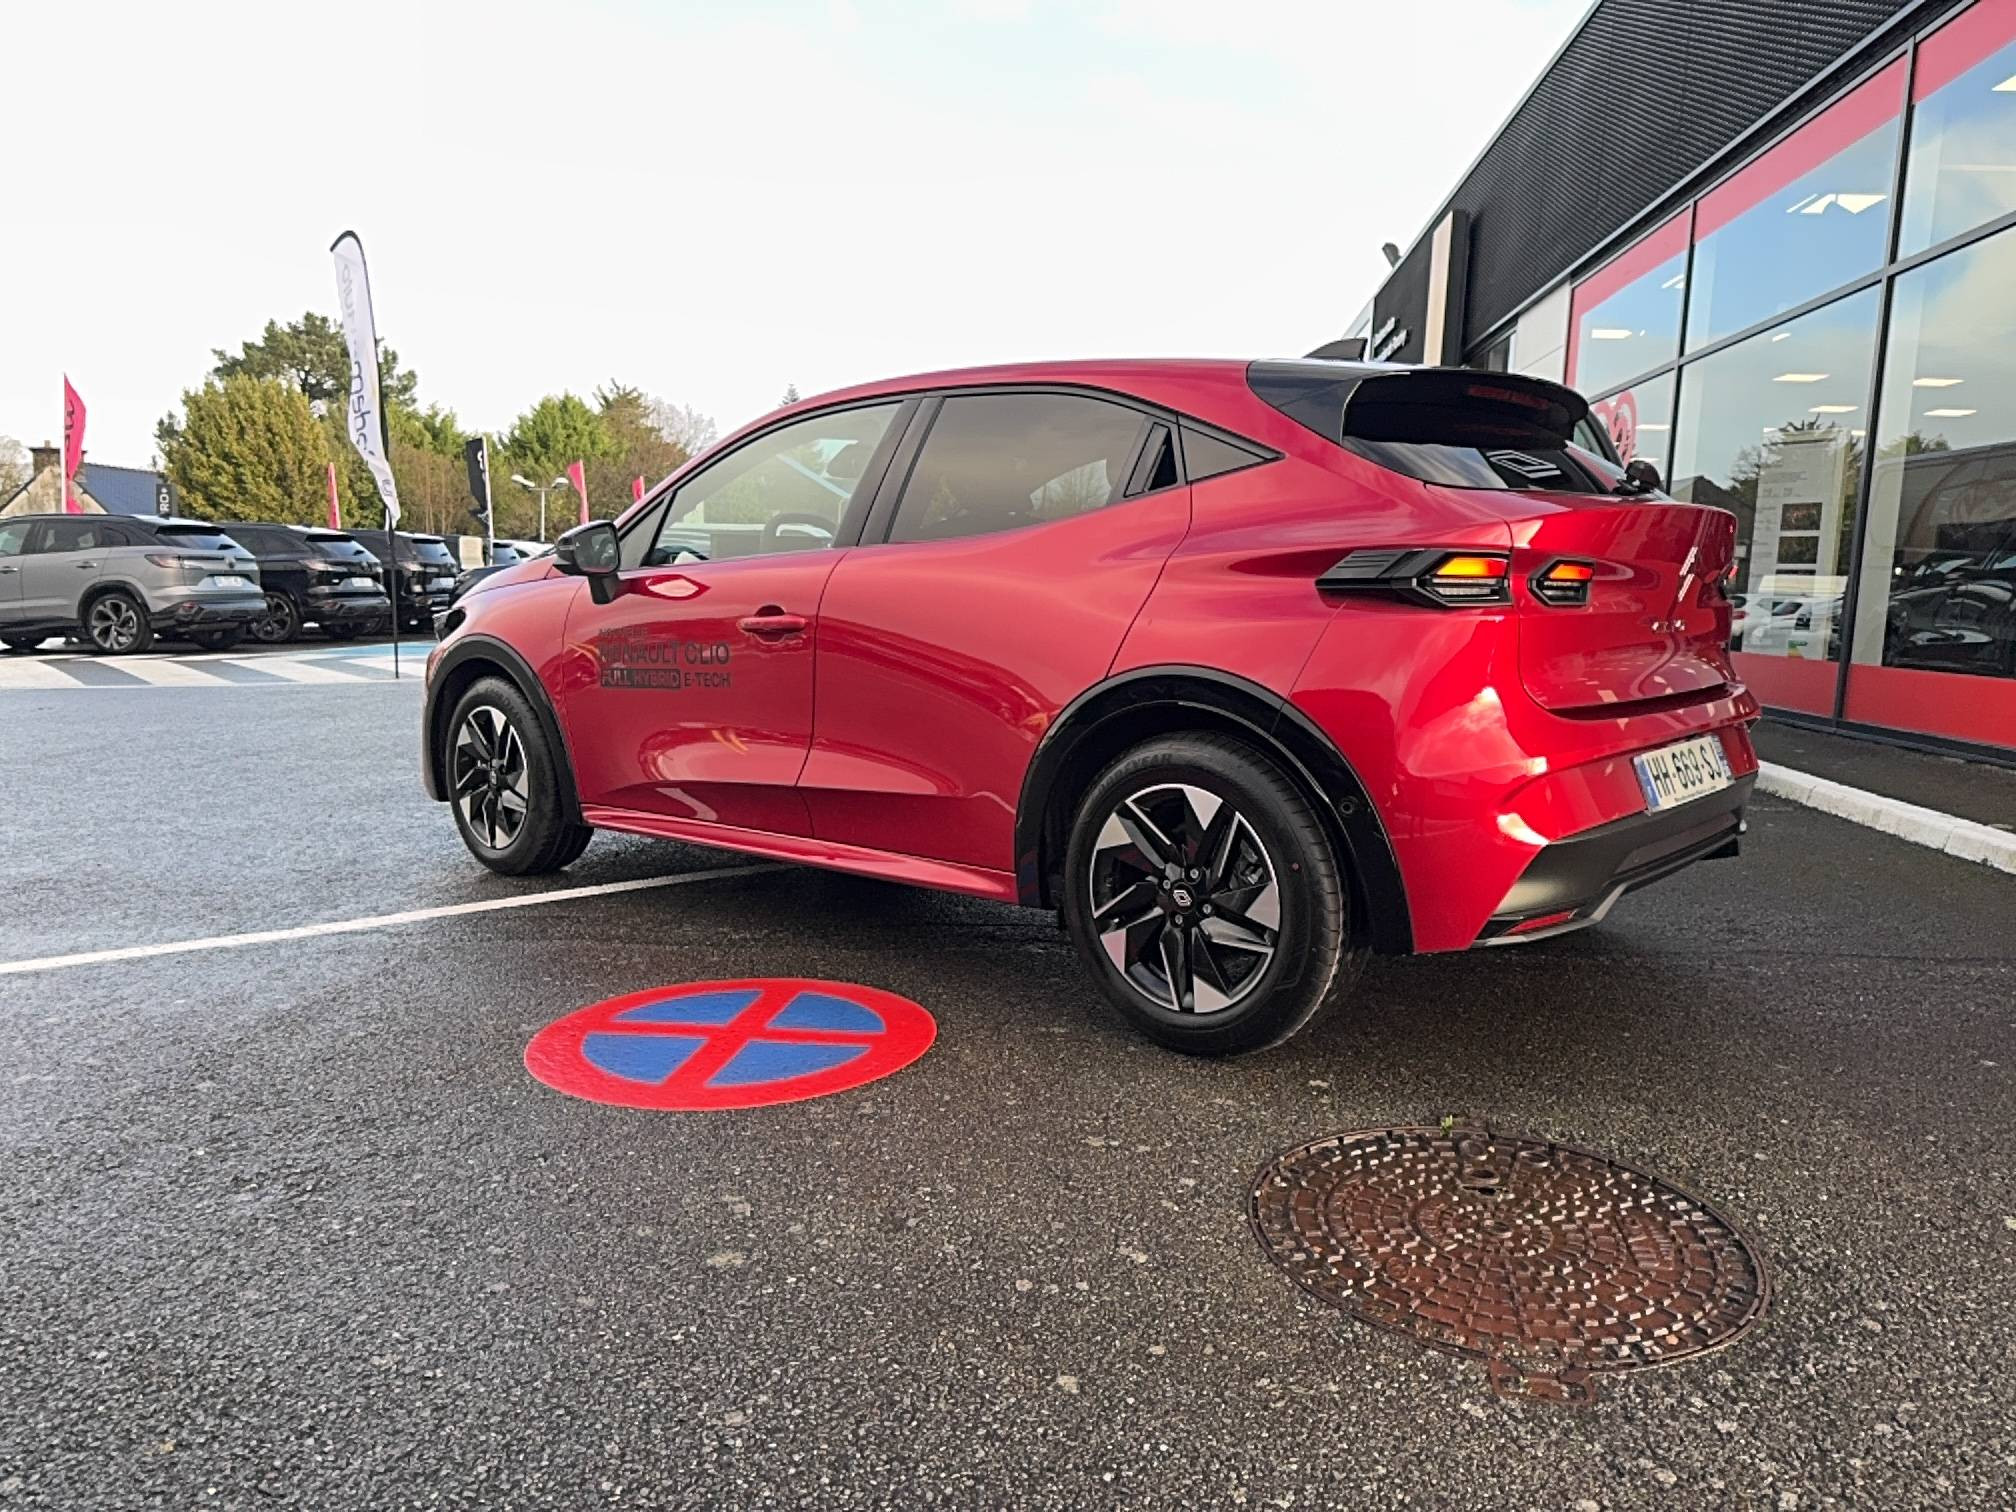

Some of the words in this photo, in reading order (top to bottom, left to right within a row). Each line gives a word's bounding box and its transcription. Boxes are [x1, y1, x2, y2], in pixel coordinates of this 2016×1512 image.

[599, 641, 678, 664] RENAULT
[684, 642, 731, 665] CLIO
[602, 669, 632, 686] FULL
